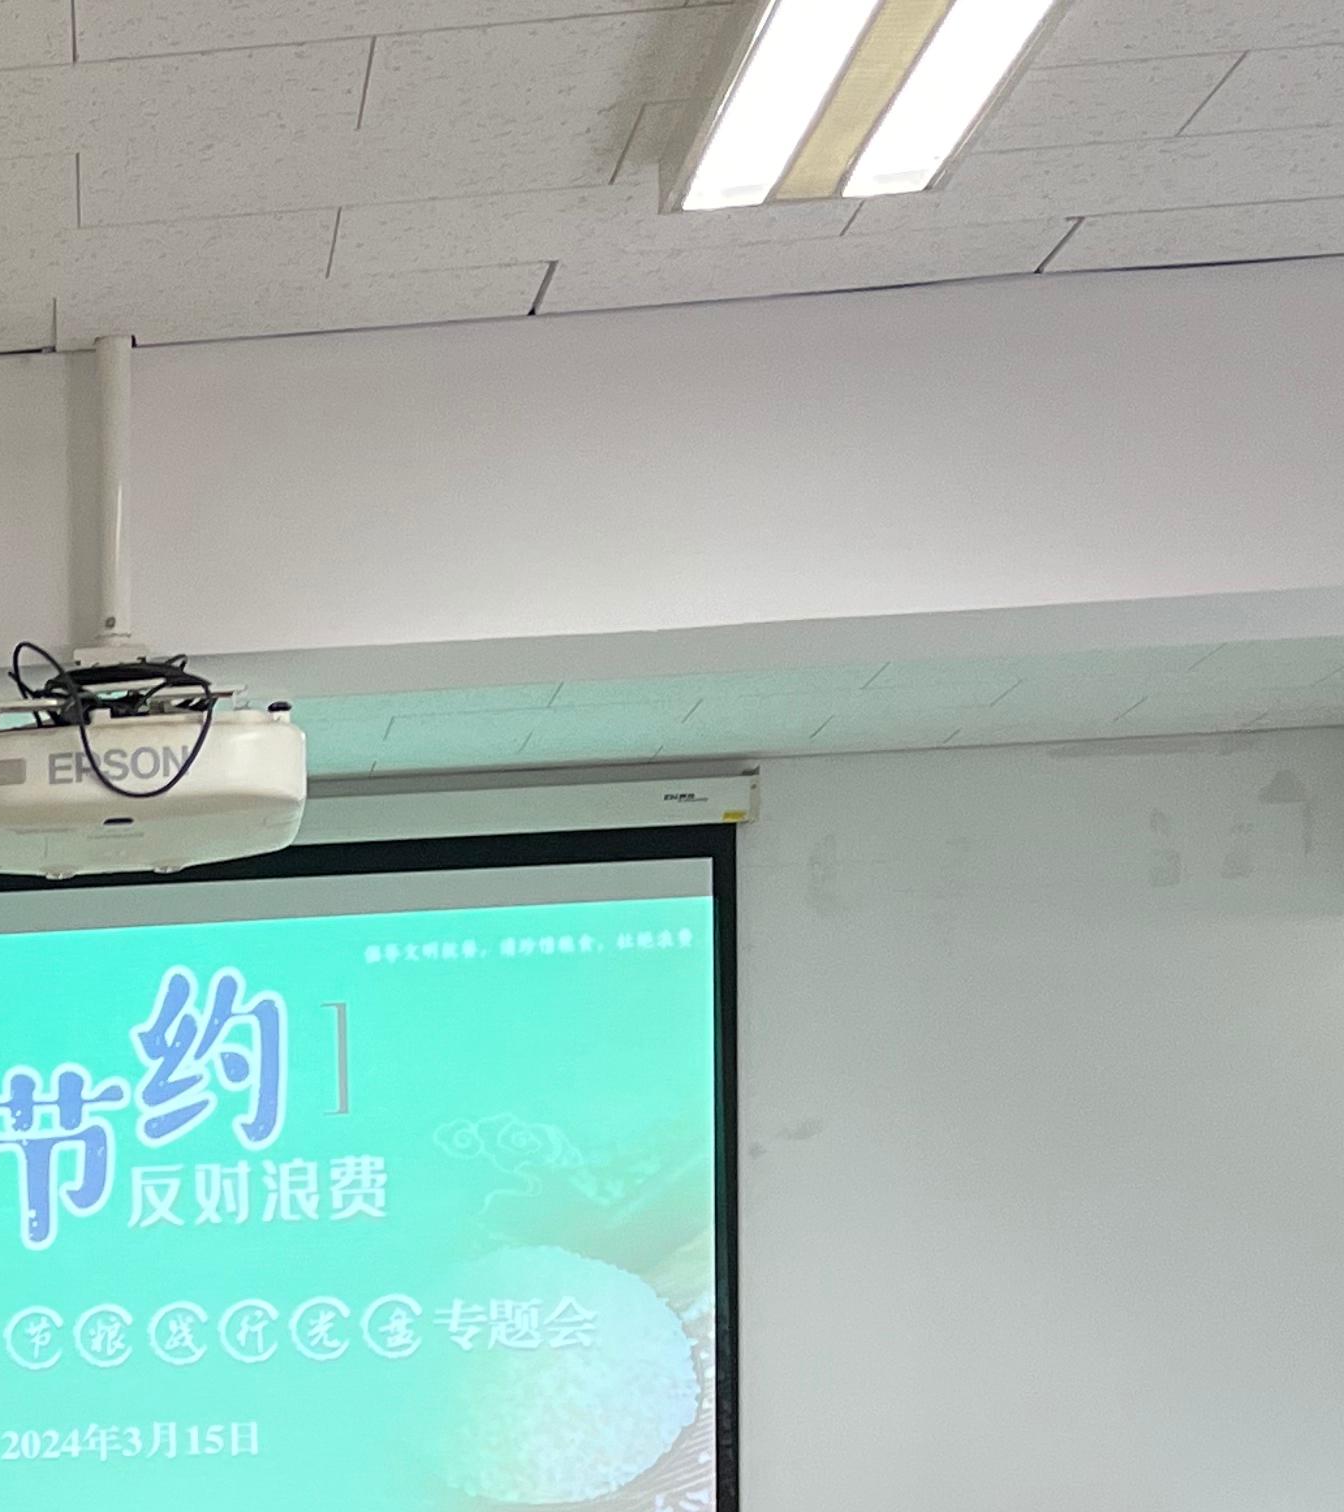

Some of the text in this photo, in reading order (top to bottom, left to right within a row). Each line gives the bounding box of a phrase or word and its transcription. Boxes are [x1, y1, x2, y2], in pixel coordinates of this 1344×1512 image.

[48, 745, 191, 785] EPSON
[127, 1154, 389, 1229] 反对浪费
[0, 1420, 259, 1462] 2024年3月15日
